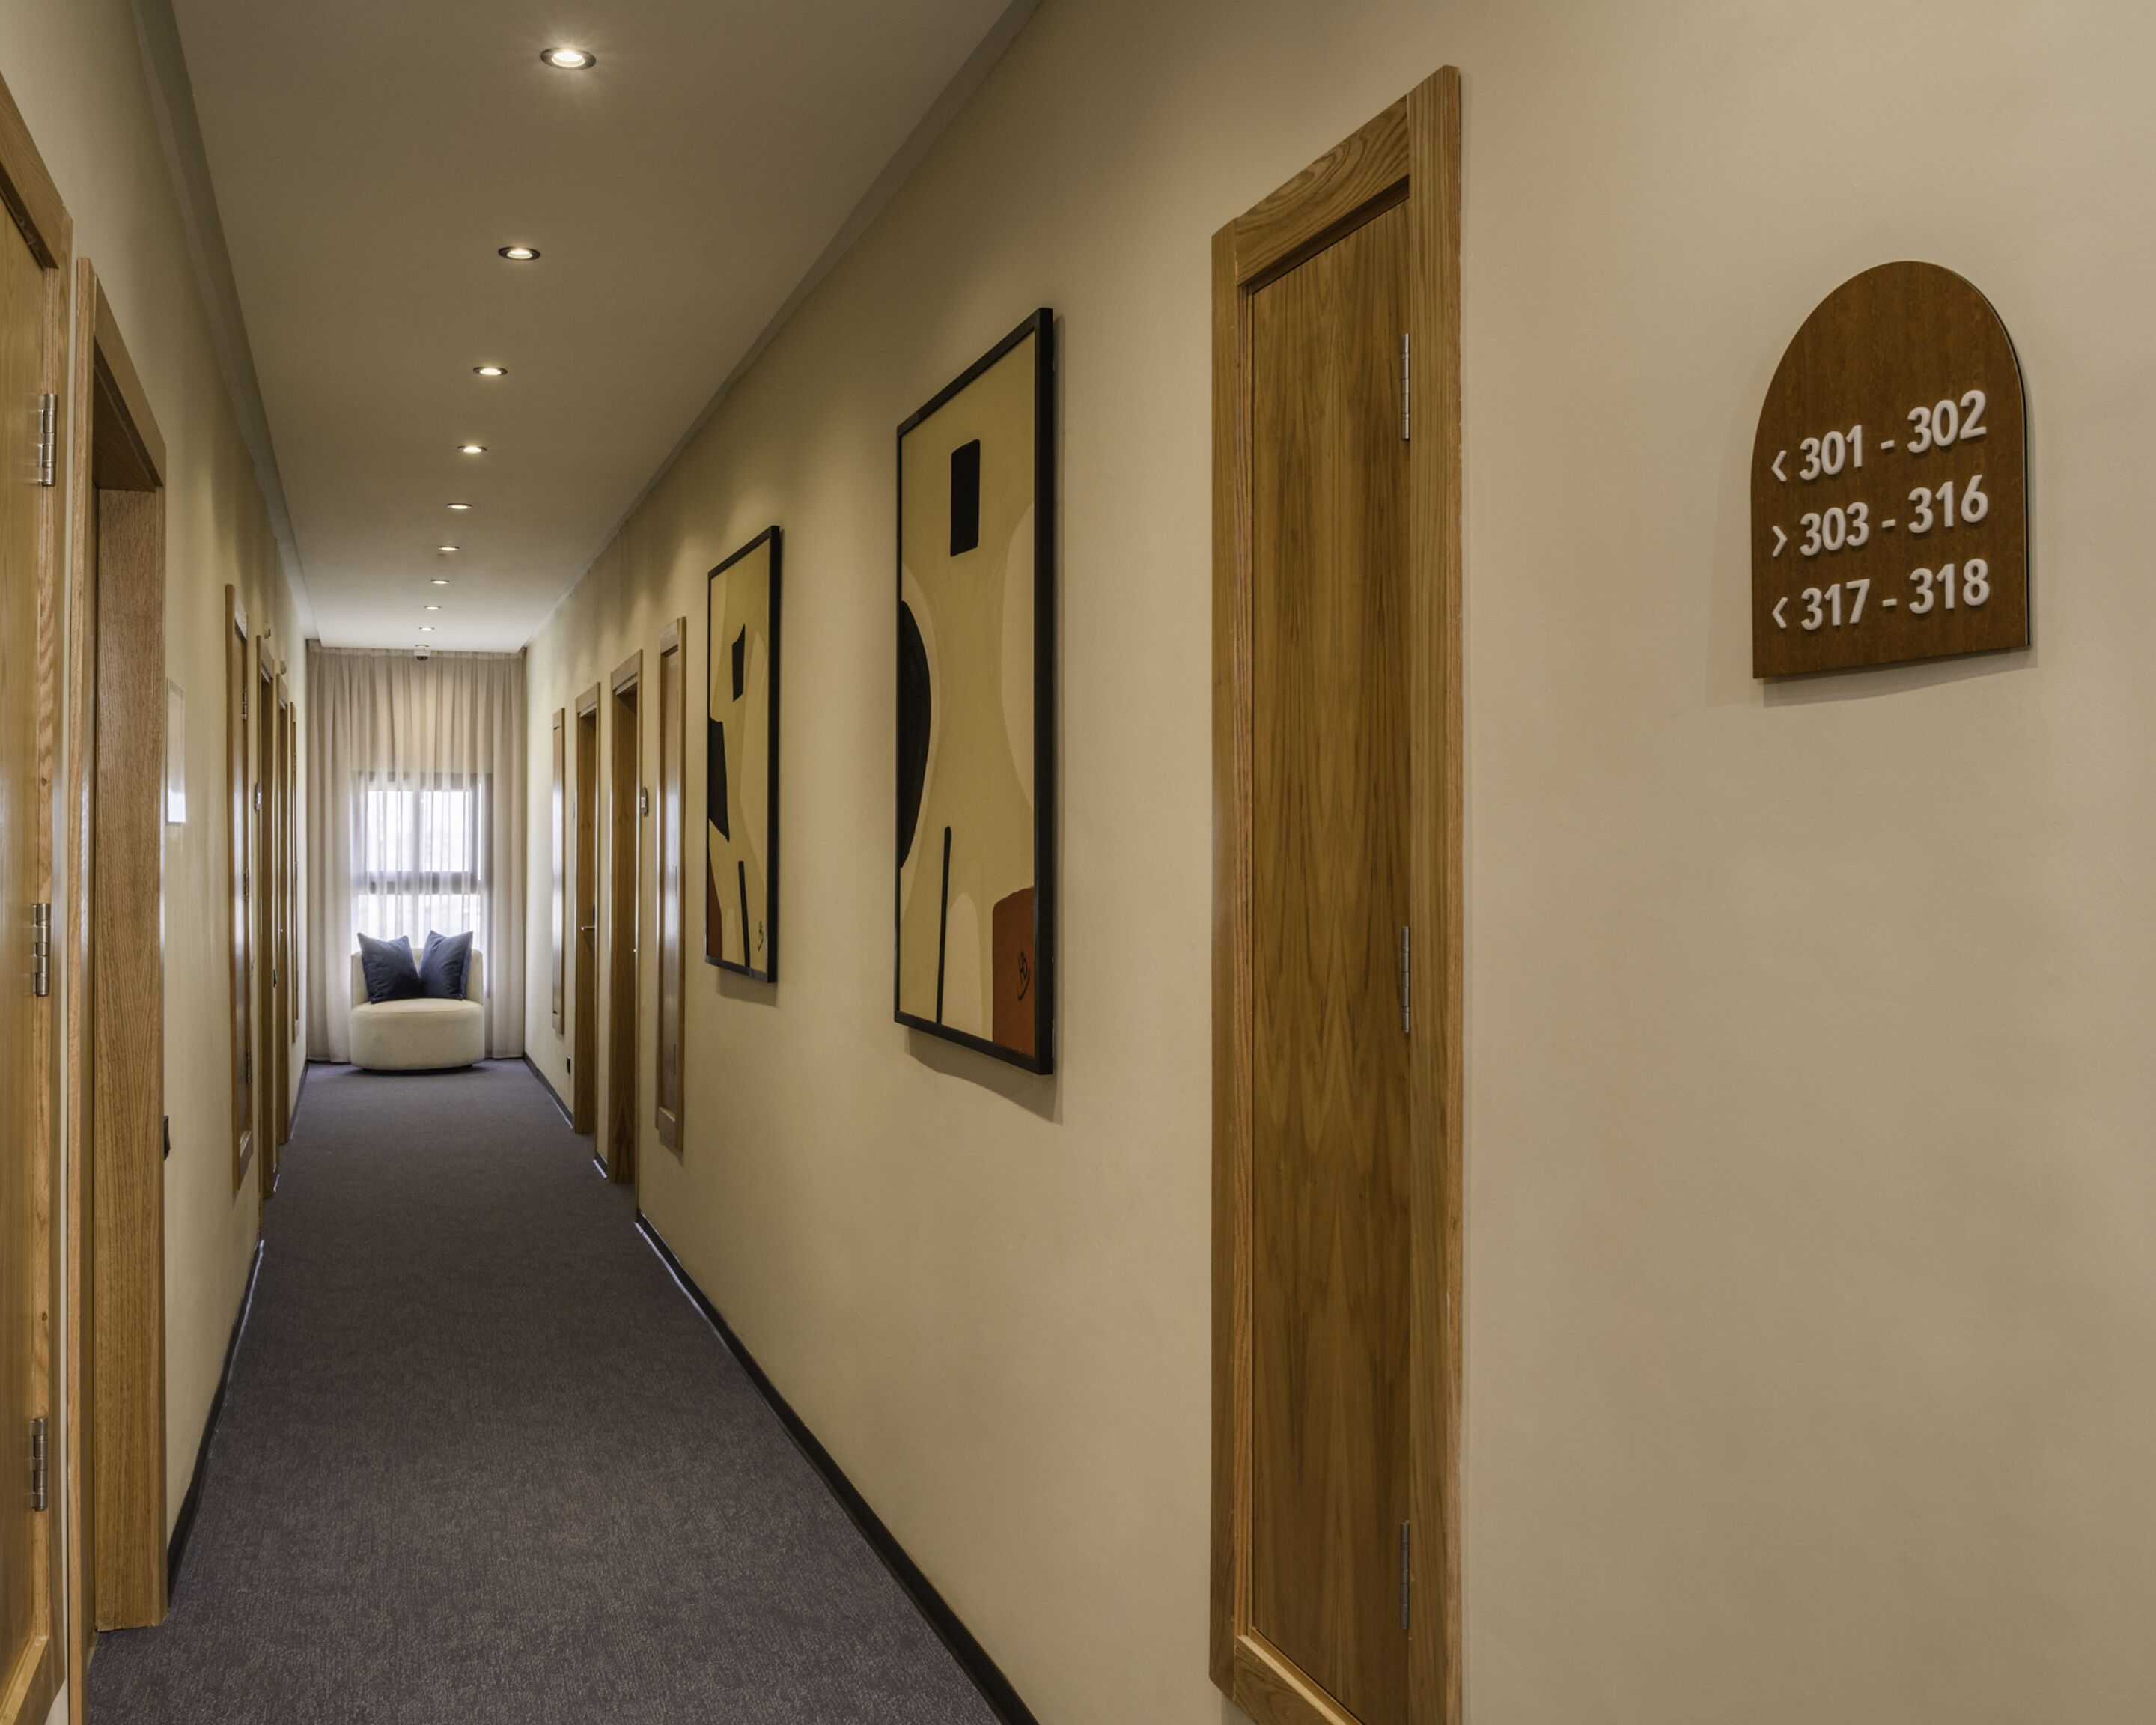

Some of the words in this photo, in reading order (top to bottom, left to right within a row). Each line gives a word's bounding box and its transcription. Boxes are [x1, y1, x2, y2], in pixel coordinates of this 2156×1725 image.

[1799, 424, 1863, 481] 301
[1907, 389, 1987, 453] 302
[1800, 502, 1869, 556] 303
[1908, 474, 1989, 533] 316
[1801, 578, 1870, 630] 317
[1909, 558, 1990, 614] 318
